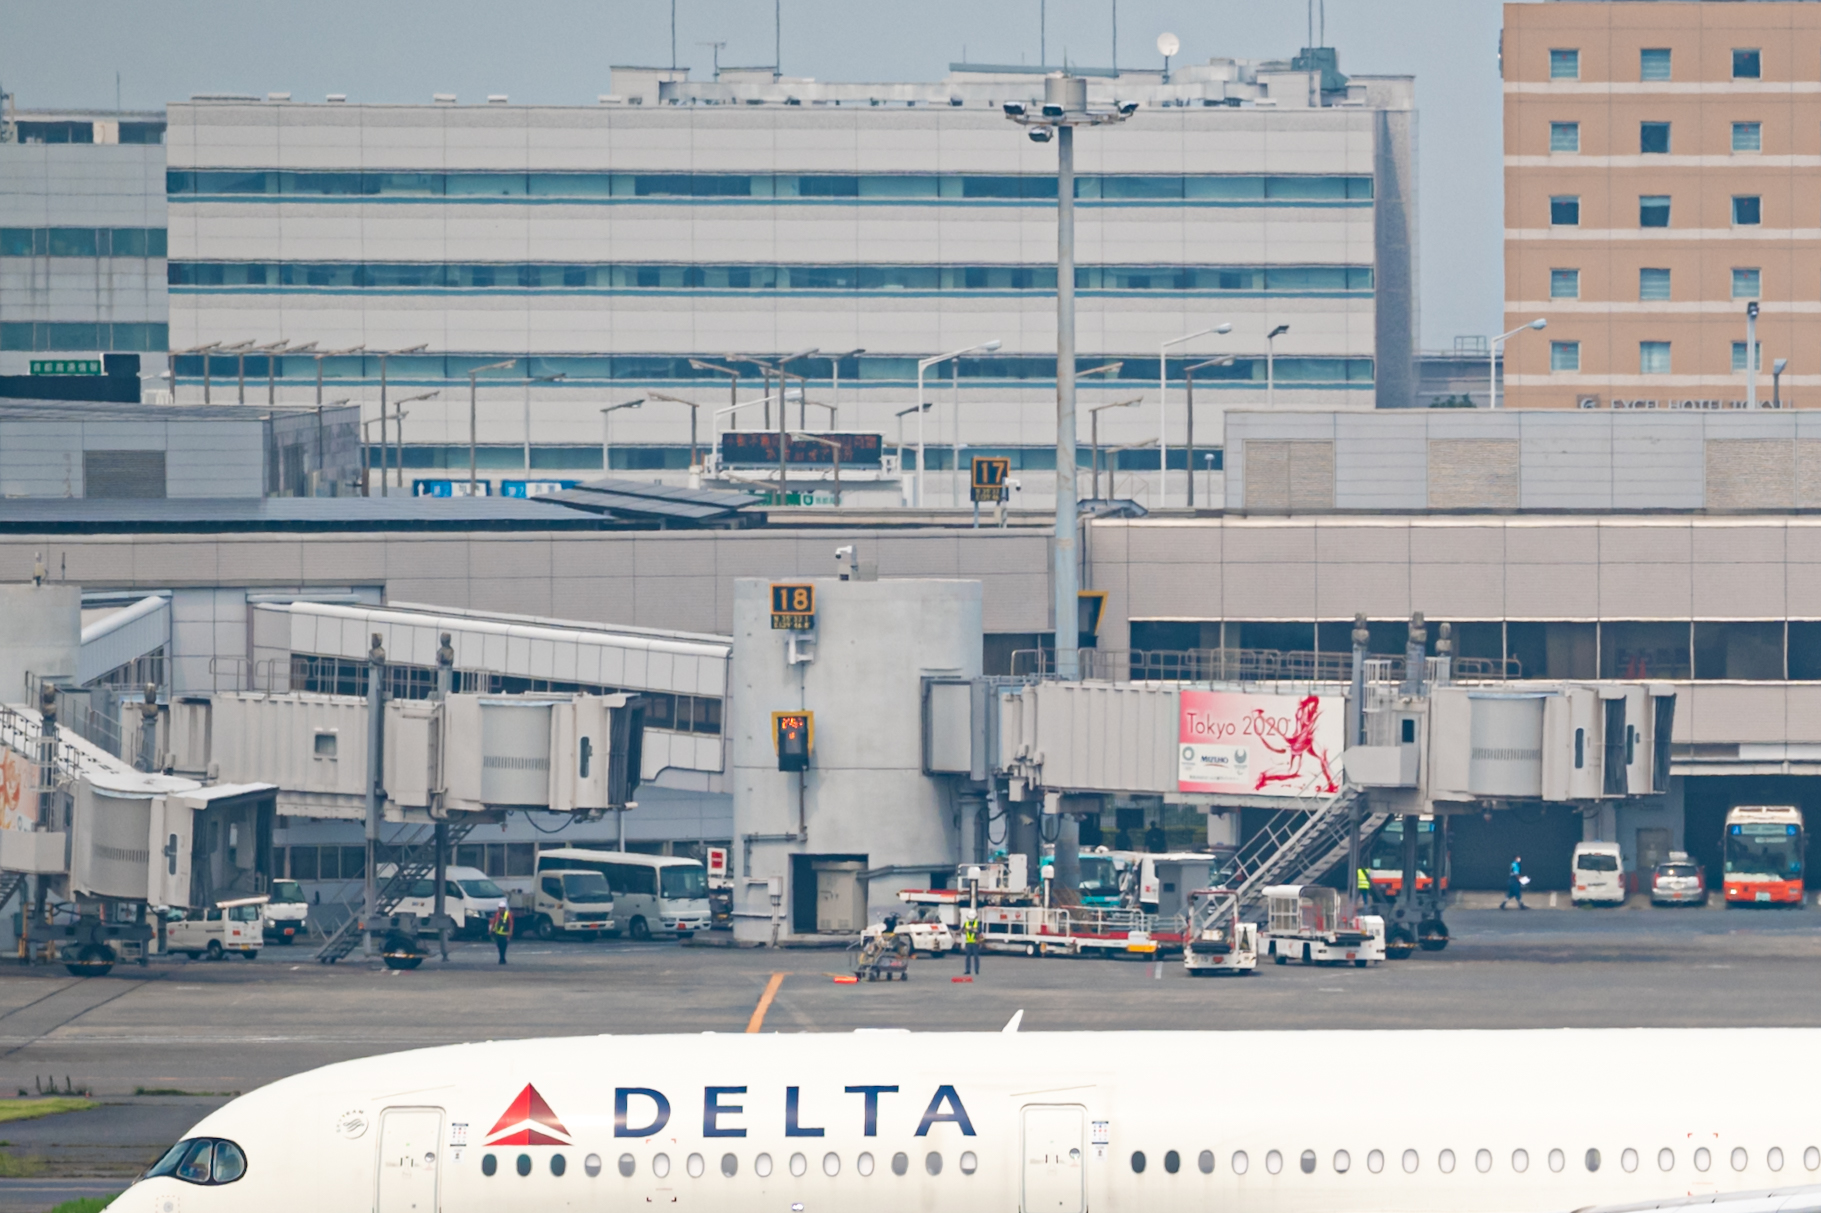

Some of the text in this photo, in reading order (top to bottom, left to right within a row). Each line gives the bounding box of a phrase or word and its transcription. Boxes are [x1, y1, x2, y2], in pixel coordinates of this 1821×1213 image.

[981, 462, 1004, 483] 17
[780, 588, 808, 610] 18
[1187, 712, 1290, 740] Tokyo 2020
[614, 1084, 977, 1138] DELTA
